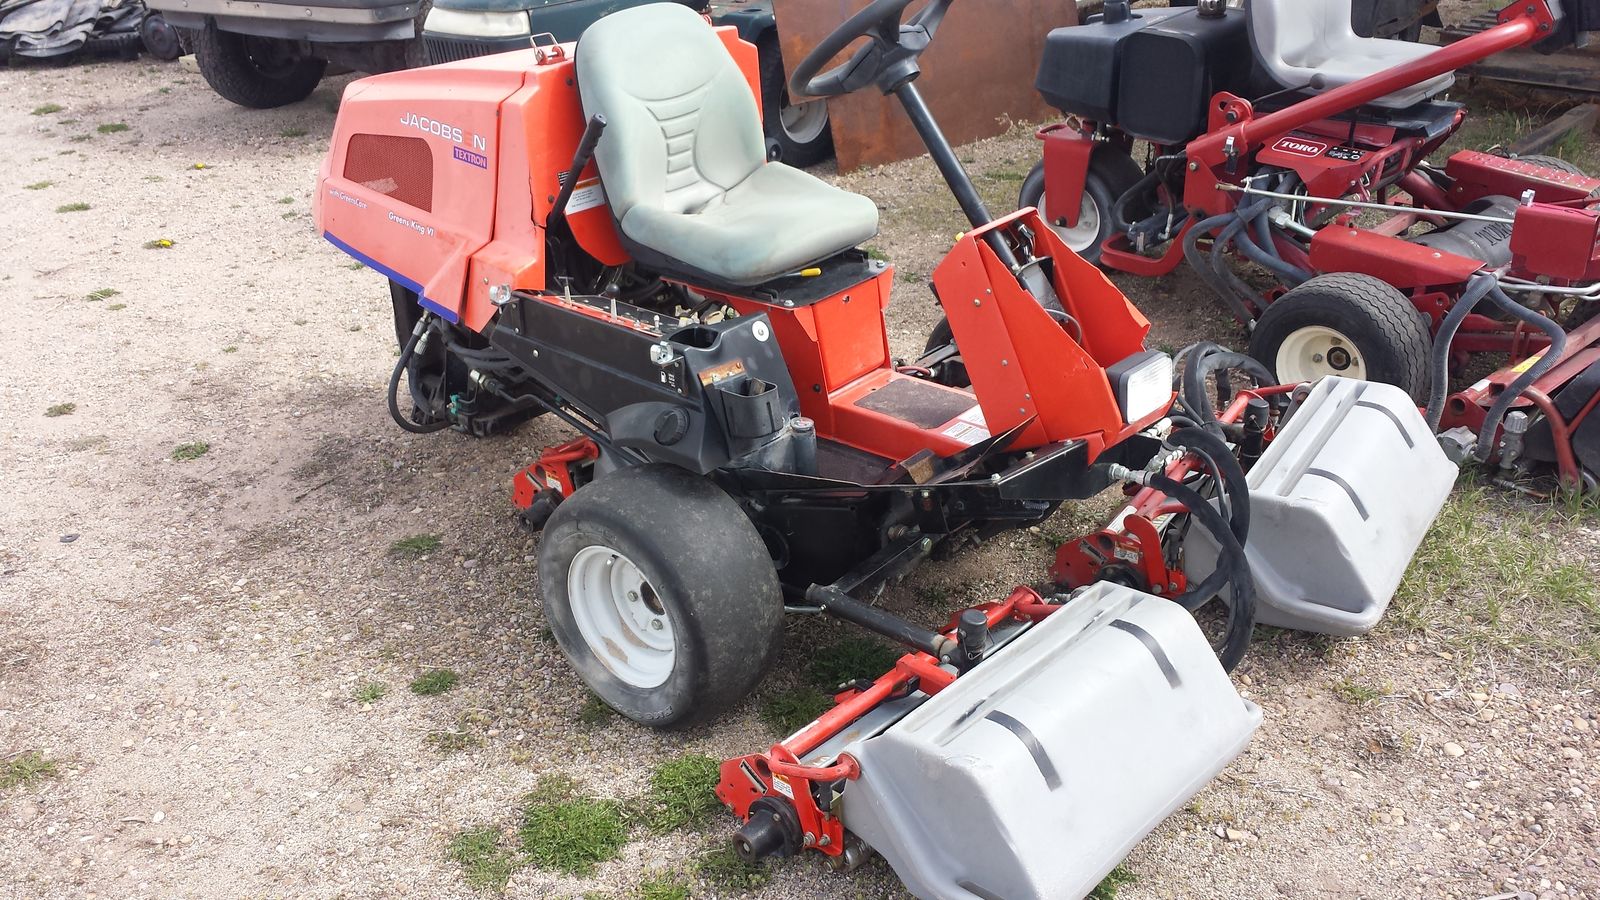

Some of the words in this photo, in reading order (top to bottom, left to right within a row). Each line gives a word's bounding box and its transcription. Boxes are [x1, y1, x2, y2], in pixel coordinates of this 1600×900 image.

[1281, 140, 1319, 153] TORO
[454, 147, 487, 168] TEXTRON
[388, 211, 410, 226] Greens
[411, 219, 425, 235] King
[427, 227, 434, 237] VI
